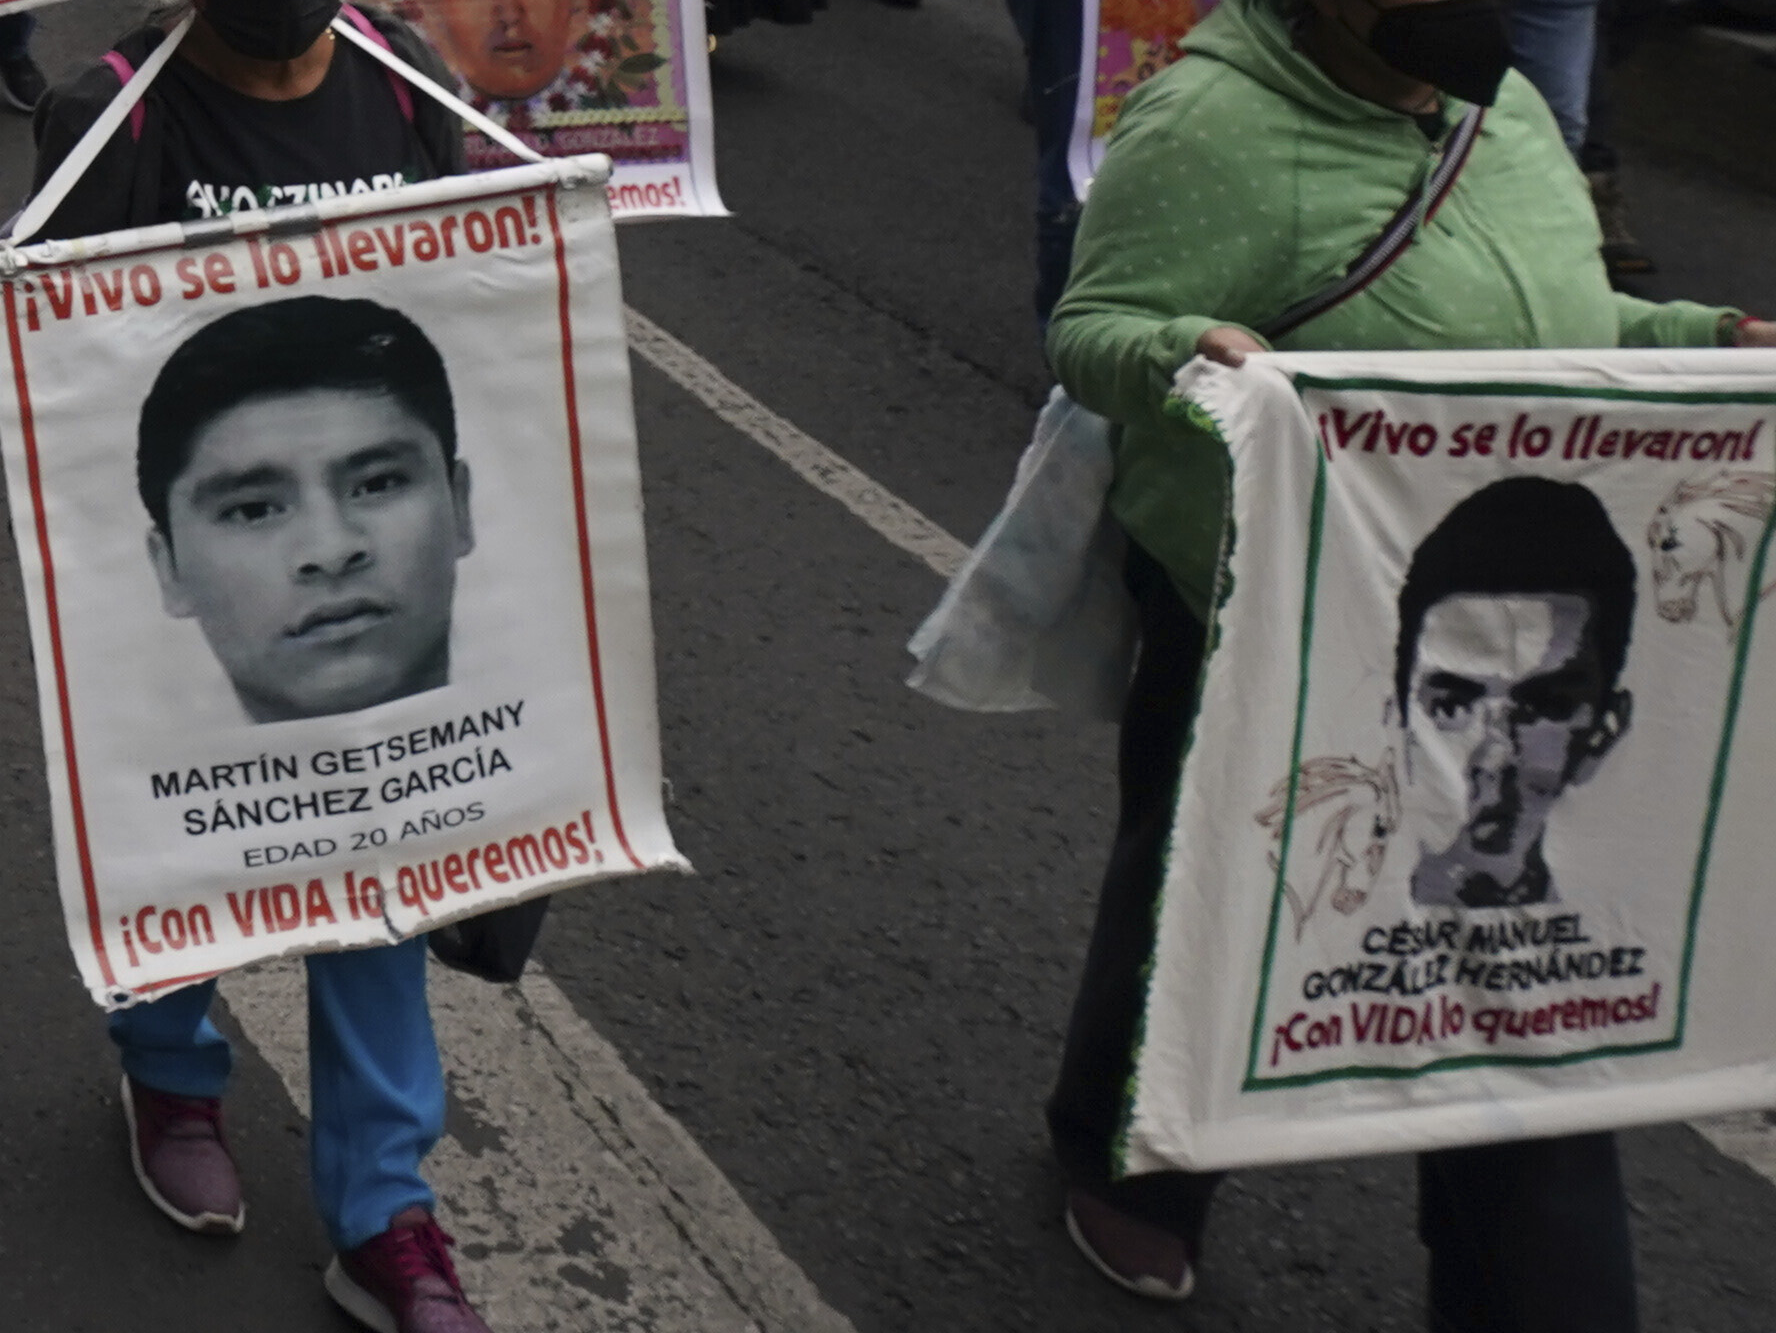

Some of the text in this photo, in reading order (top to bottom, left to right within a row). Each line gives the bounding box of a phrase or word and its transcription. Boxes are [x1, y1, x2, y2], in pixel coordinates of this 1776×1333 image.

[24, 193, 545, 332] ¡Vivo se lo llevaron!
[1317, 405, 1761, 464] ¡Vivo se lo llevaron!
[150, 700, 526, 800] MARTÍN GETSEMANY
[183, 745, 514, 837] SÁNCHEZ GARCÍA
[243, 798, 487, 869] EDAD 20 AÑOS
[119, 809, 605, 968] ¡Con VIDA lo queremos!
[1455, 945, 1646, 991] HERNÁNDEZ
[1471, 911, 1592, 955] MANUEL
[1269, 982, 1662, 1067] ¡Con VIDA lo queremos!
